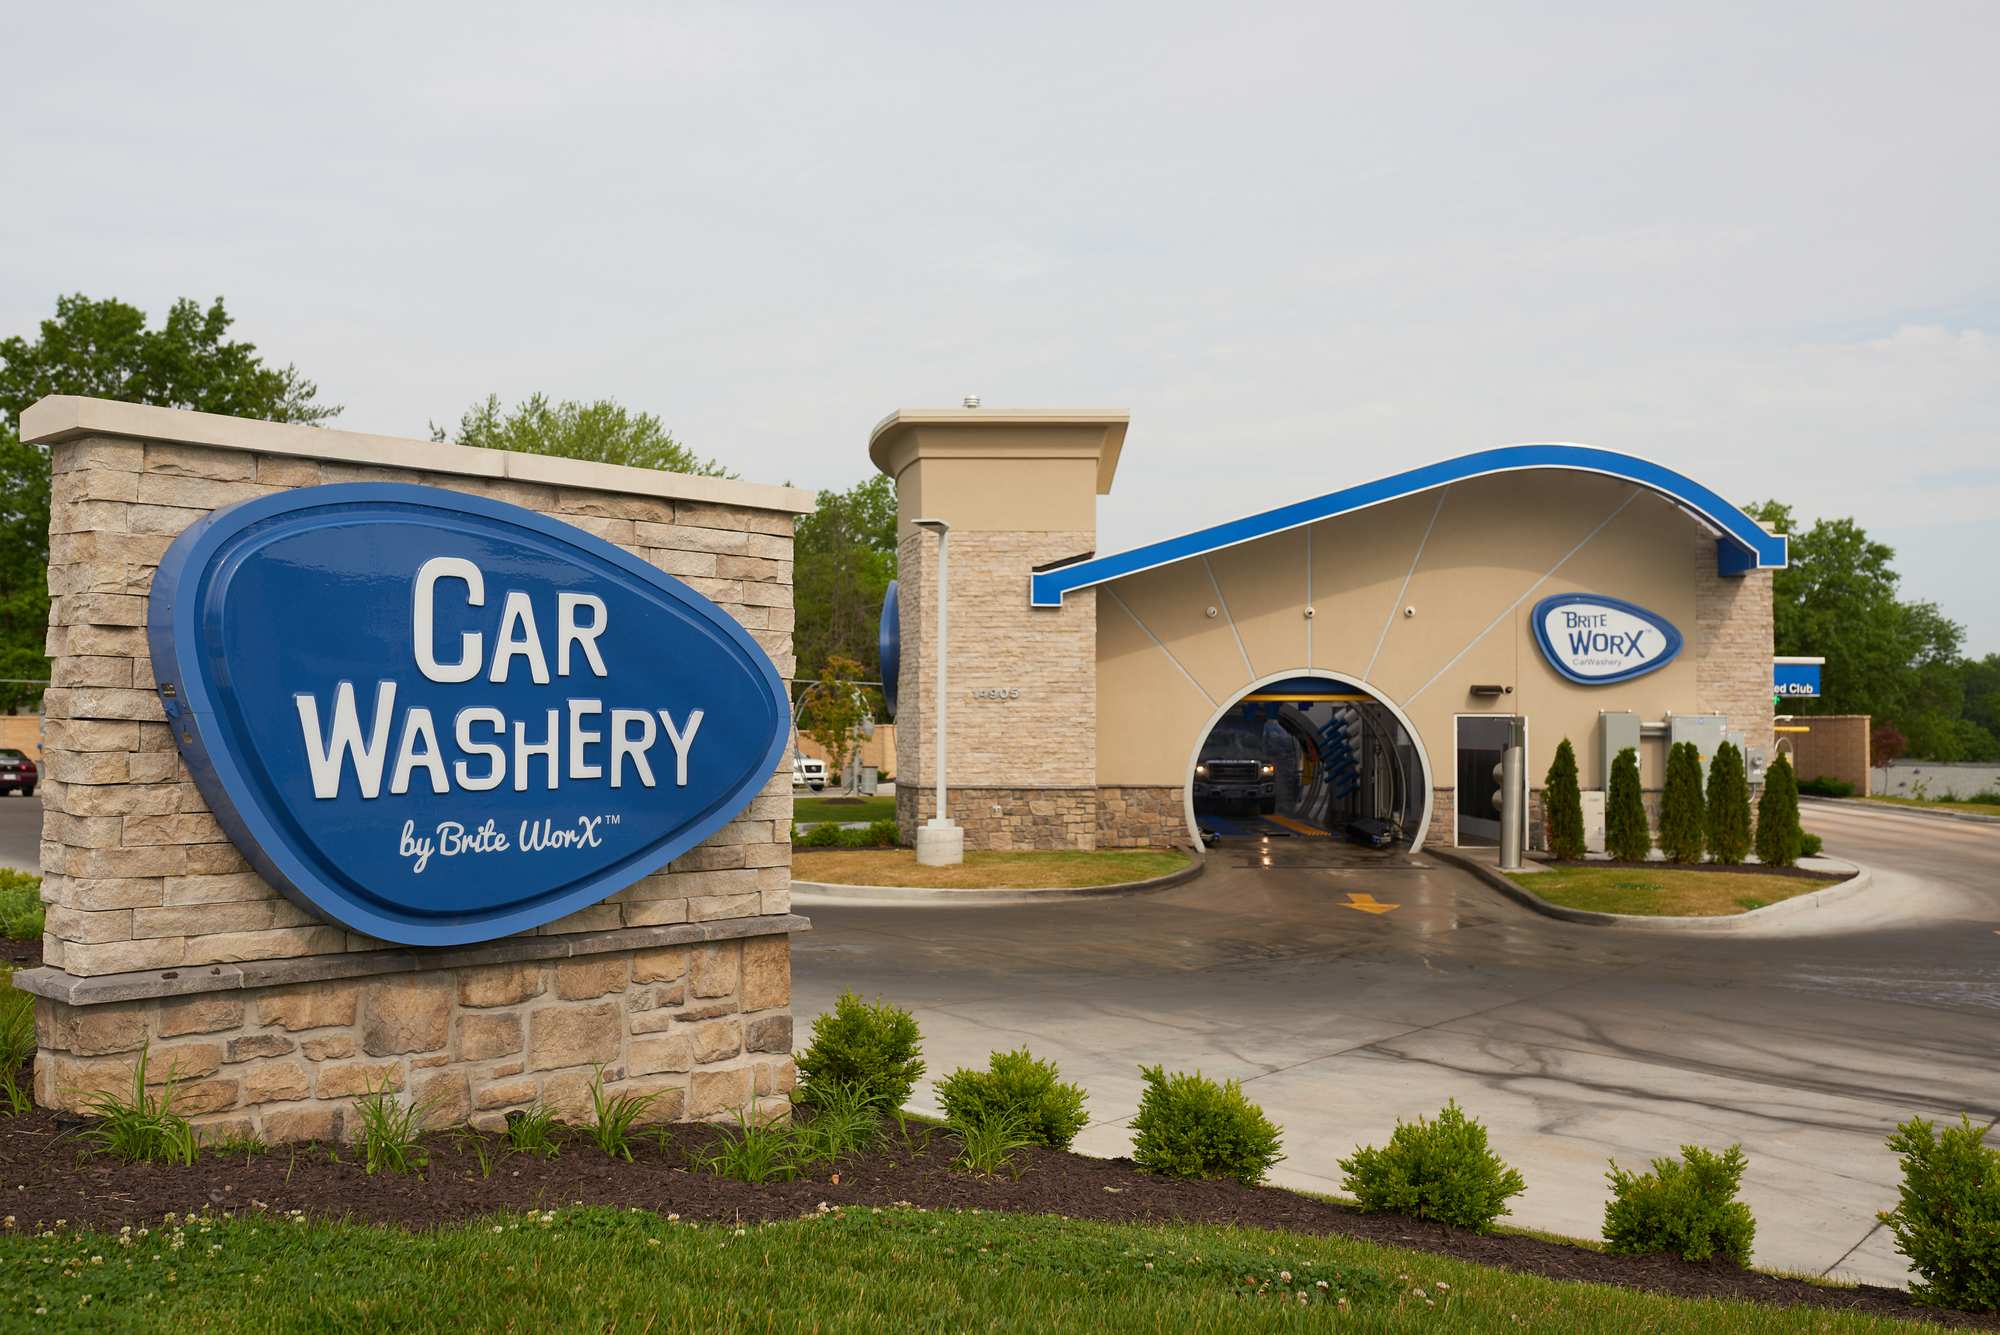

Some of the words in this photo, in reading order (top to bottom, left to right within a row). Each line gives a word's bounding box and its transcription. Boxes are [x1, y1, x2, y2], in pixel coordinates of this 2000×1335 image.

[412, 556, 608, 685] CAR
[1568, 630, 1645, 659] WORX
[1789, 683, 1814, 694] Club
[295, 680, 704, 800] WASHERY
[399, 819, 435, 874] by
[436, 818, 510, 857] Brite
